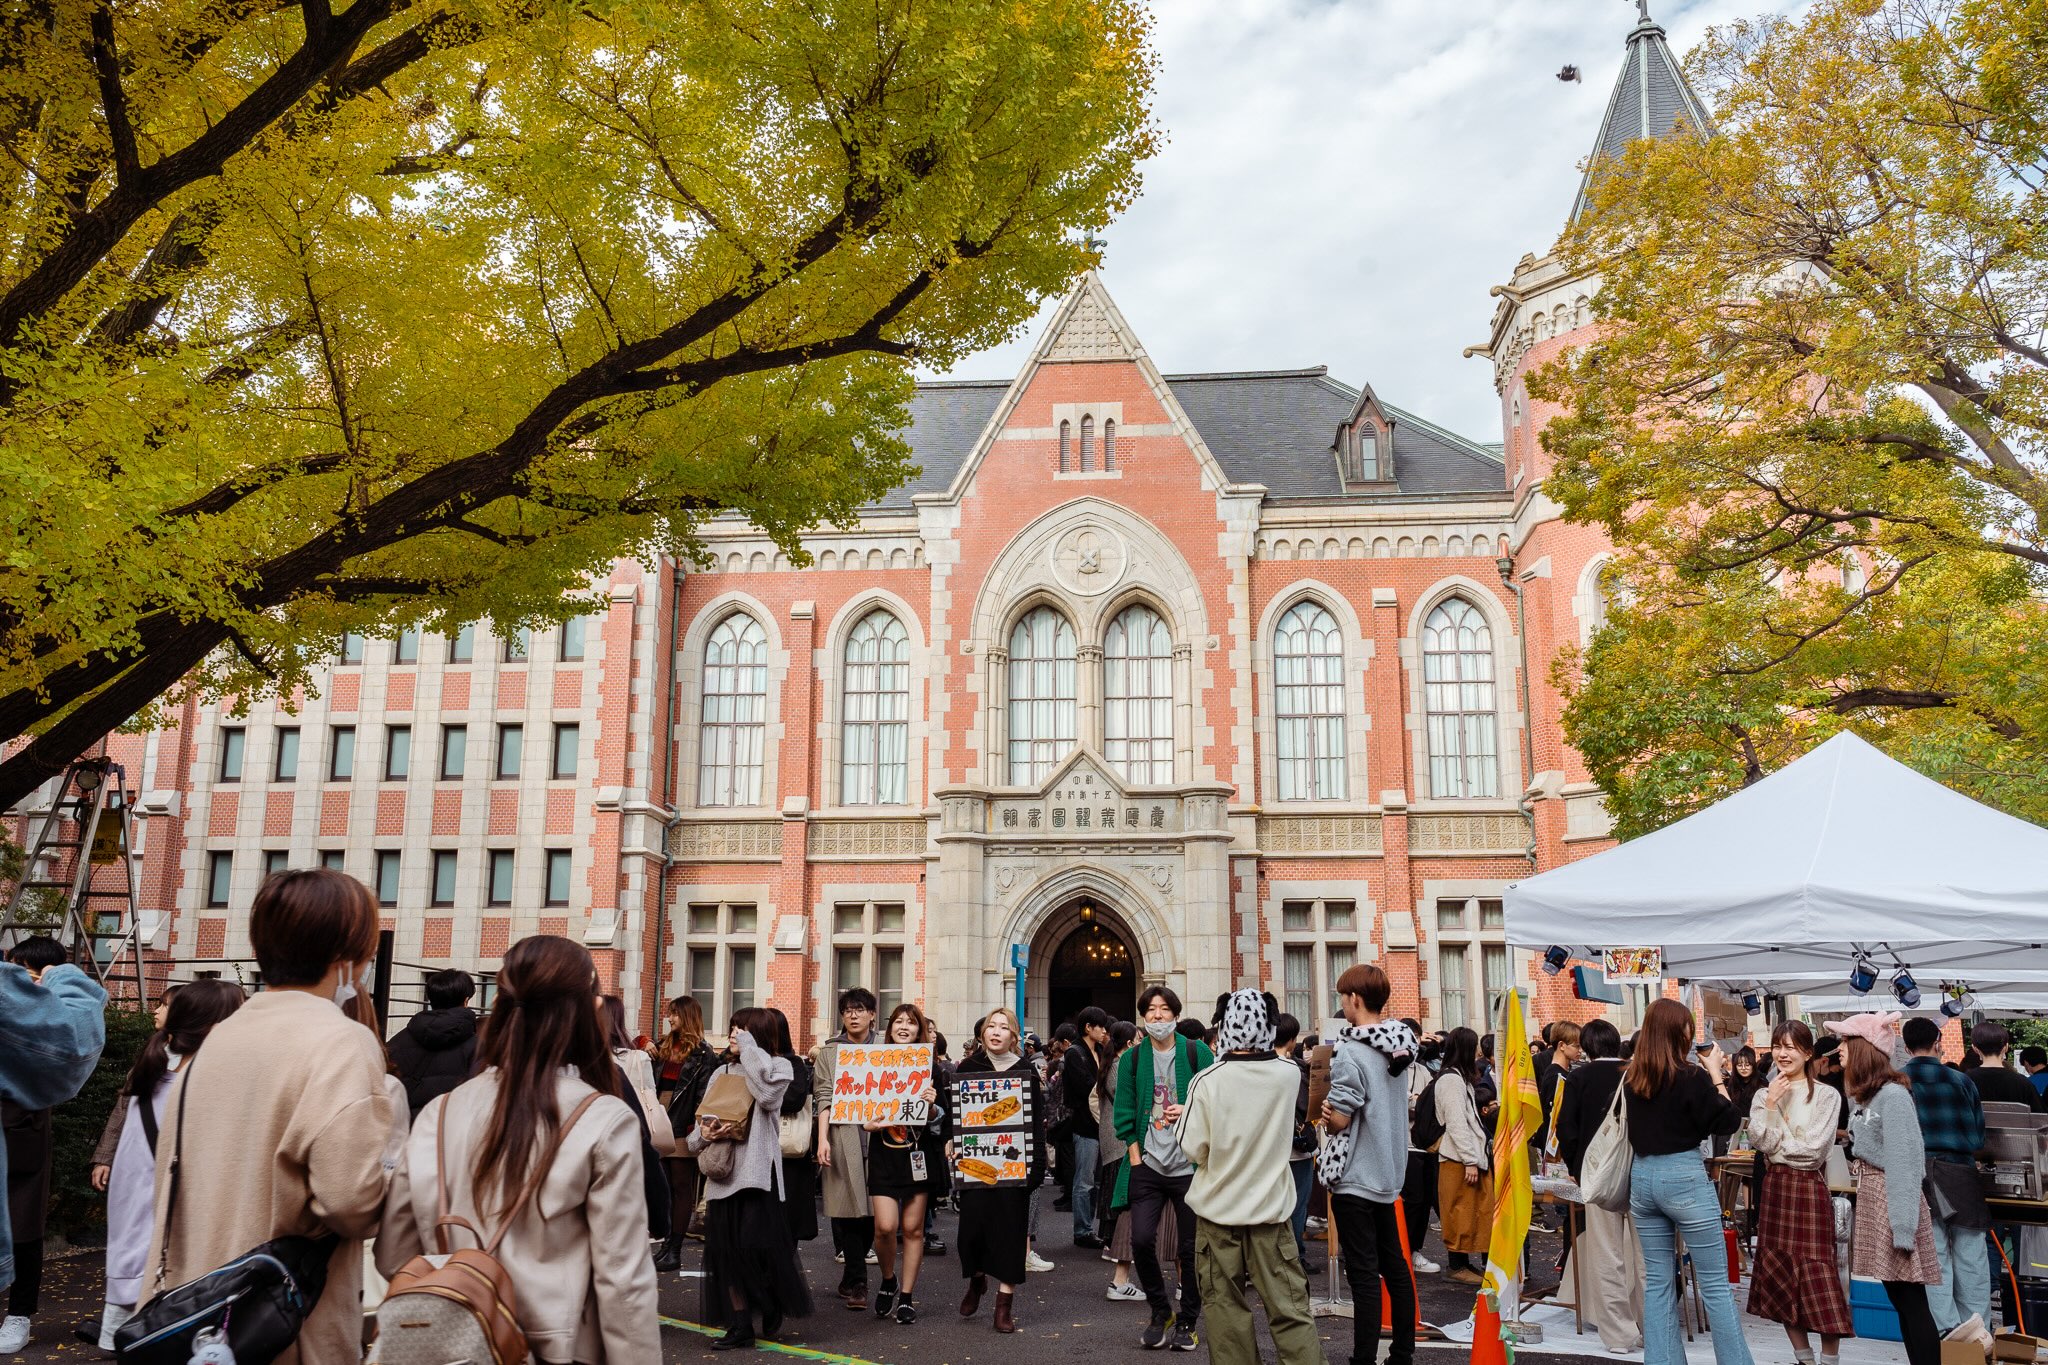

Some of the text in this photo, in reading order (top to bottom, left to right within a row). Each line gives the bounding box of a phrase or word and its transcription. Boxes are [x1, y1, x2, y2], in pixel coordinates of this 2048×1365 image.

[839, 1046, 931, 1067] シネマ研究会
[835, 1069, 930, 1095] ホットドッグ
[961, 1091, 999, 1104] STYLE
[963, 1134, 1013, 1146] MEXICAN
[963, 1145, 1000, 1157] STYLE
